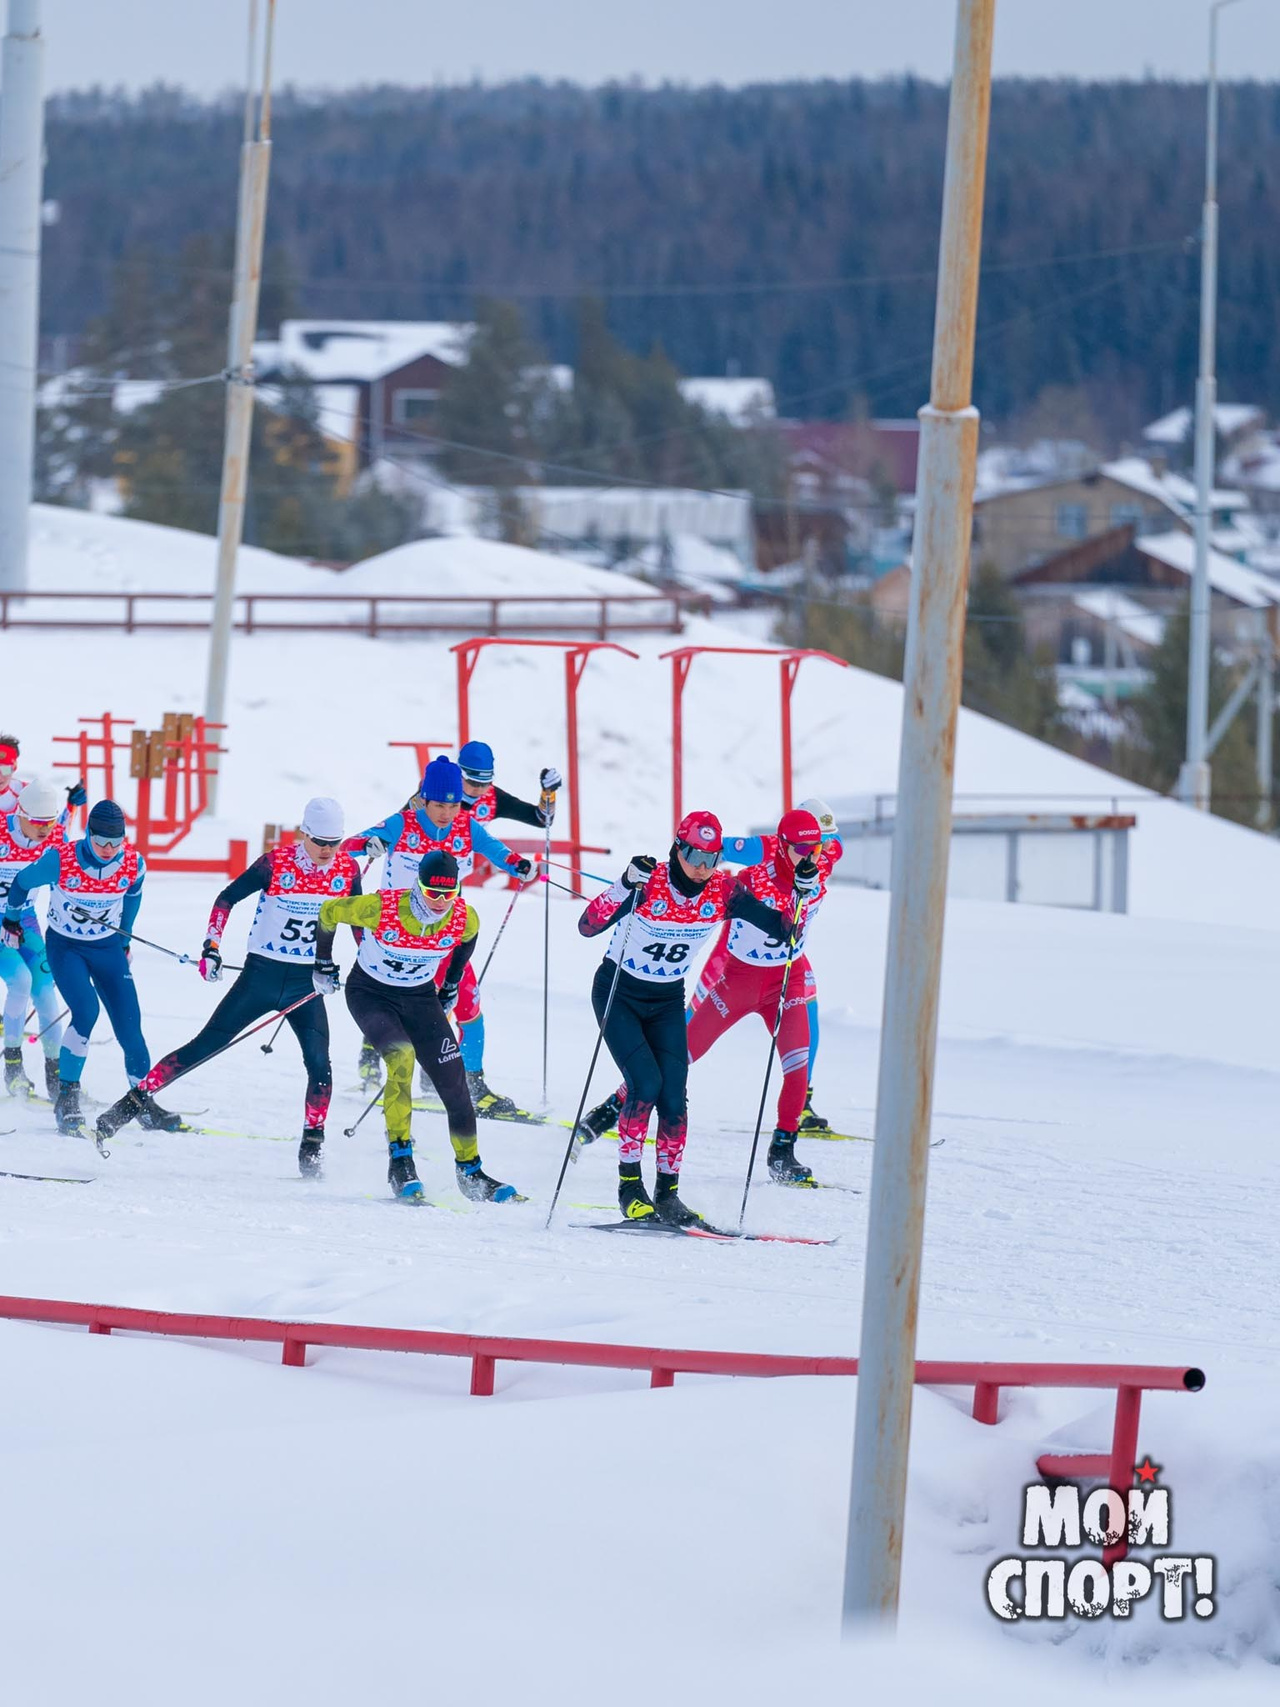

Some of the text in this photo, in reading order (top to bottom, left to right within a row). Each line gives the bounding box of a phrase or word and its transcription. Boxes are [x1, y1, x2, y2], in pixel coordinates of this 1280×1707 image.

[280, 917, 320, 944] 53
[642, 942, 690, 964] 48
[382, 959, 427, 975] 47
